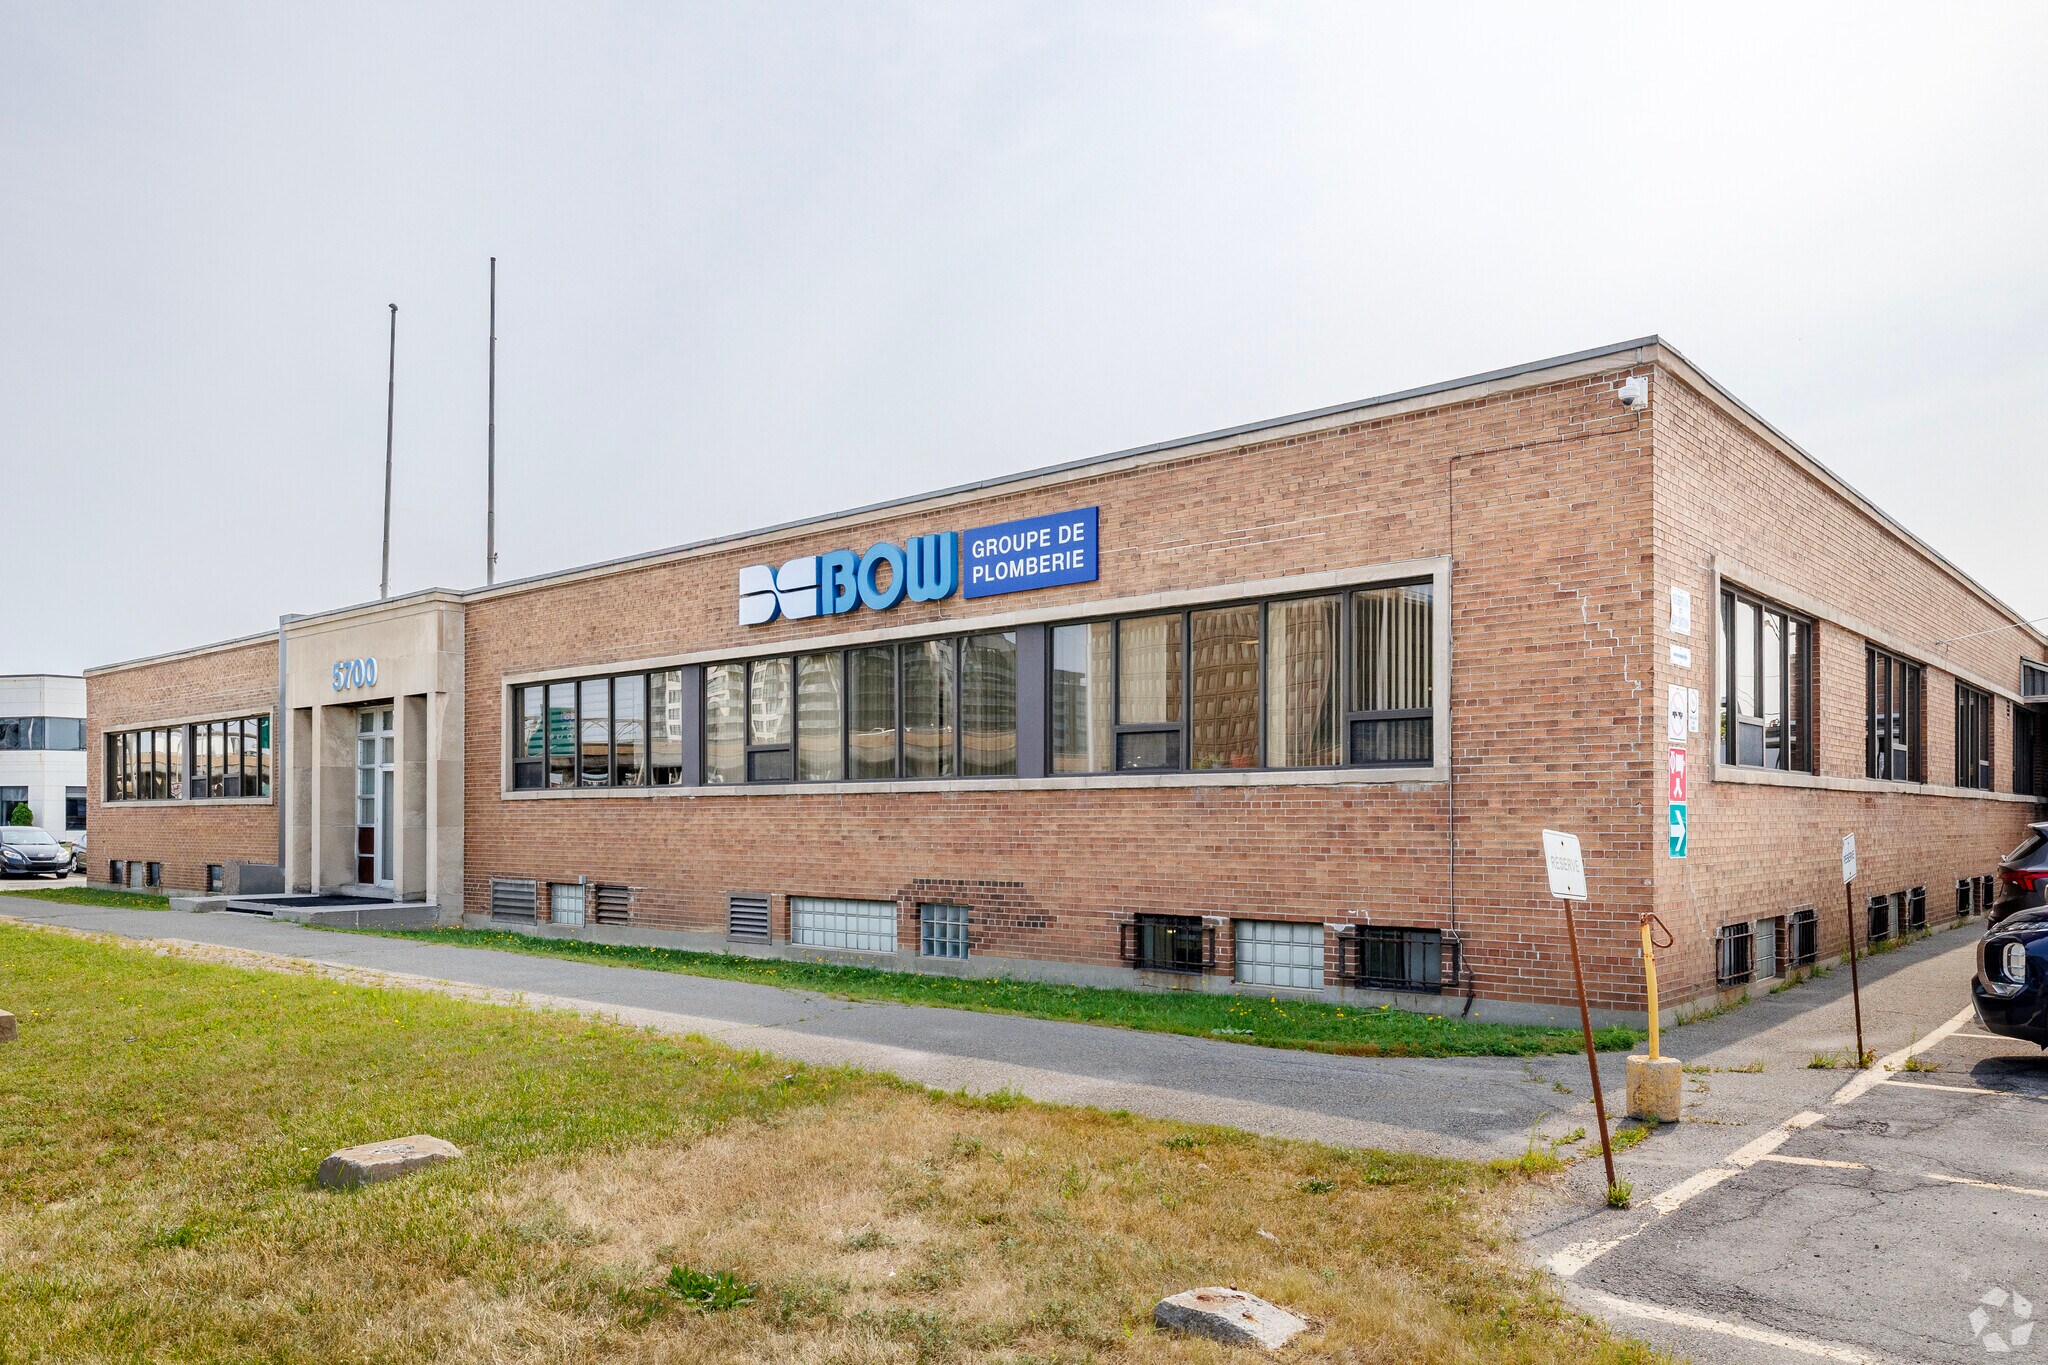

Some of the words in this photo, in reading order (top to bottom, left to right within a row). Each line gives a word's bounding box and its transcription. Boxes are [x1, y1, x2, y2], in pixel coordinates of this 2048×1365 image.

[972, 528, 1051, 558] GROUPE
[1058, 522, 1085, 542] DE
[822, 531, 958, 611] BOW
[972, 549, 1085, 583] PLOMBERIE
[332, 657, 378, 691] 5700
